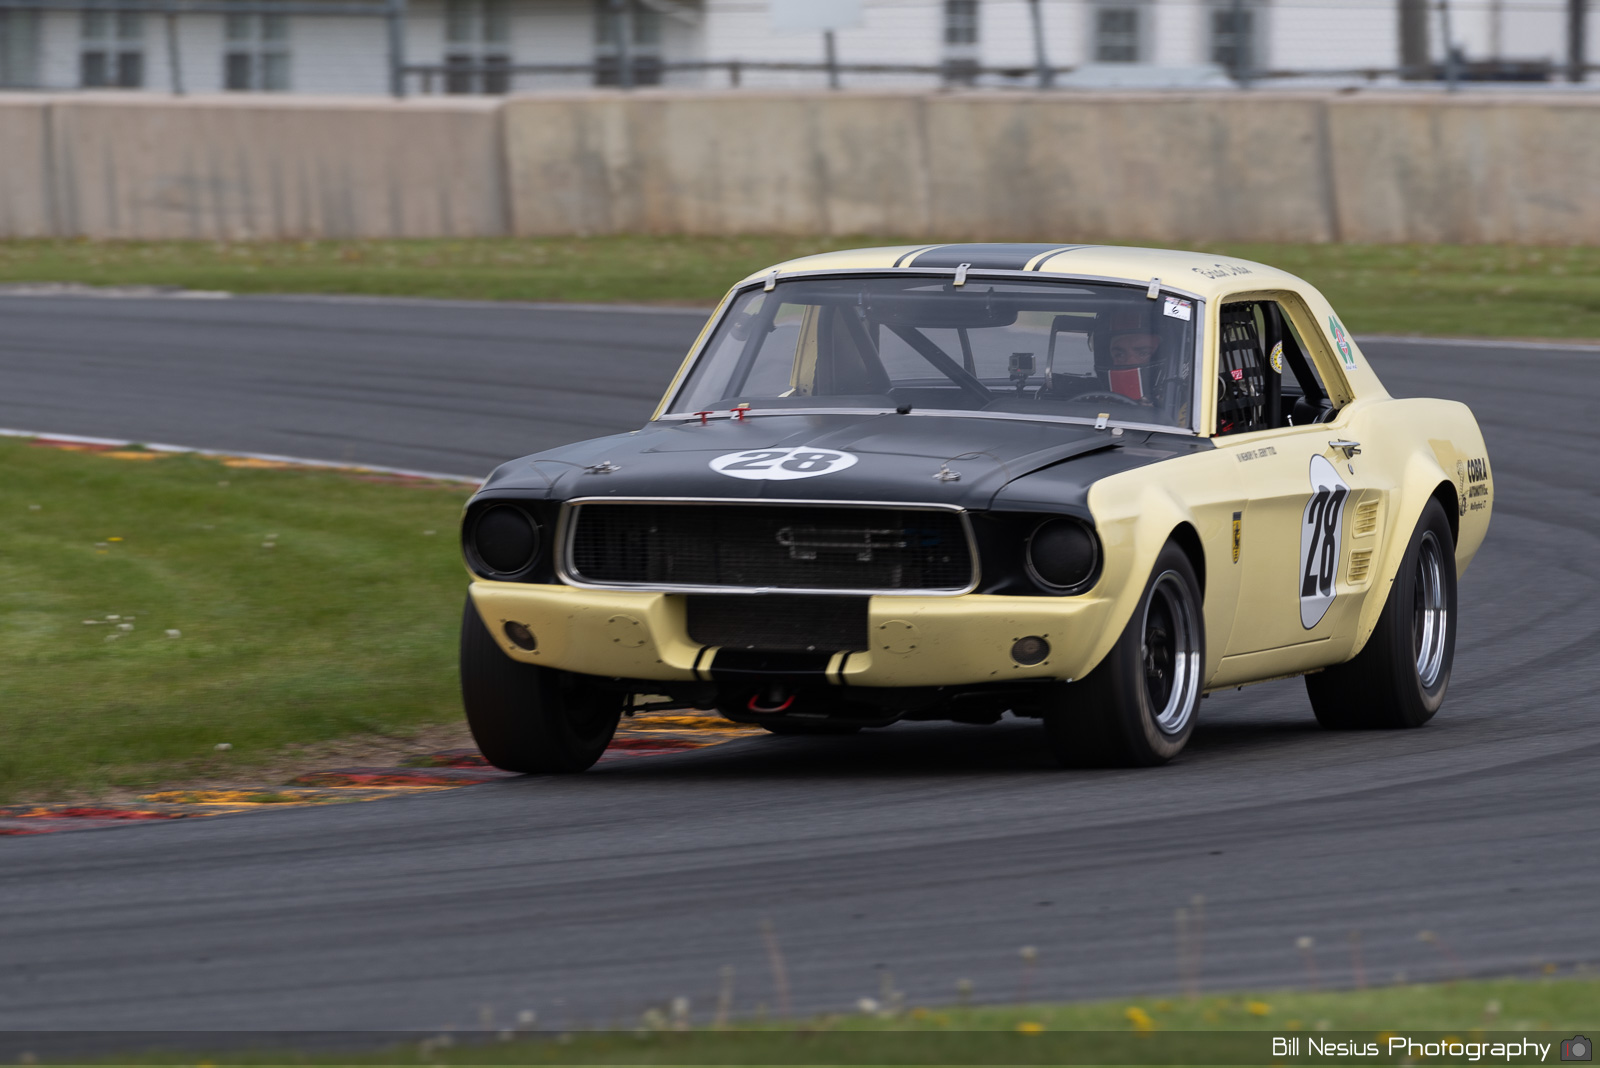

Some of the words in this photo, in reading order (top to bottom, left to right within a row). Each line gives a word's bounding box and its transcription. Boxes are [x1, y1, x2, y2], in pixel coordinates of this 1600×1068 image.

[720, 451, 843, 473] 28
[1467, 457, 1488, 483] COBRA
[1301, 484, 1347, 597] 28
